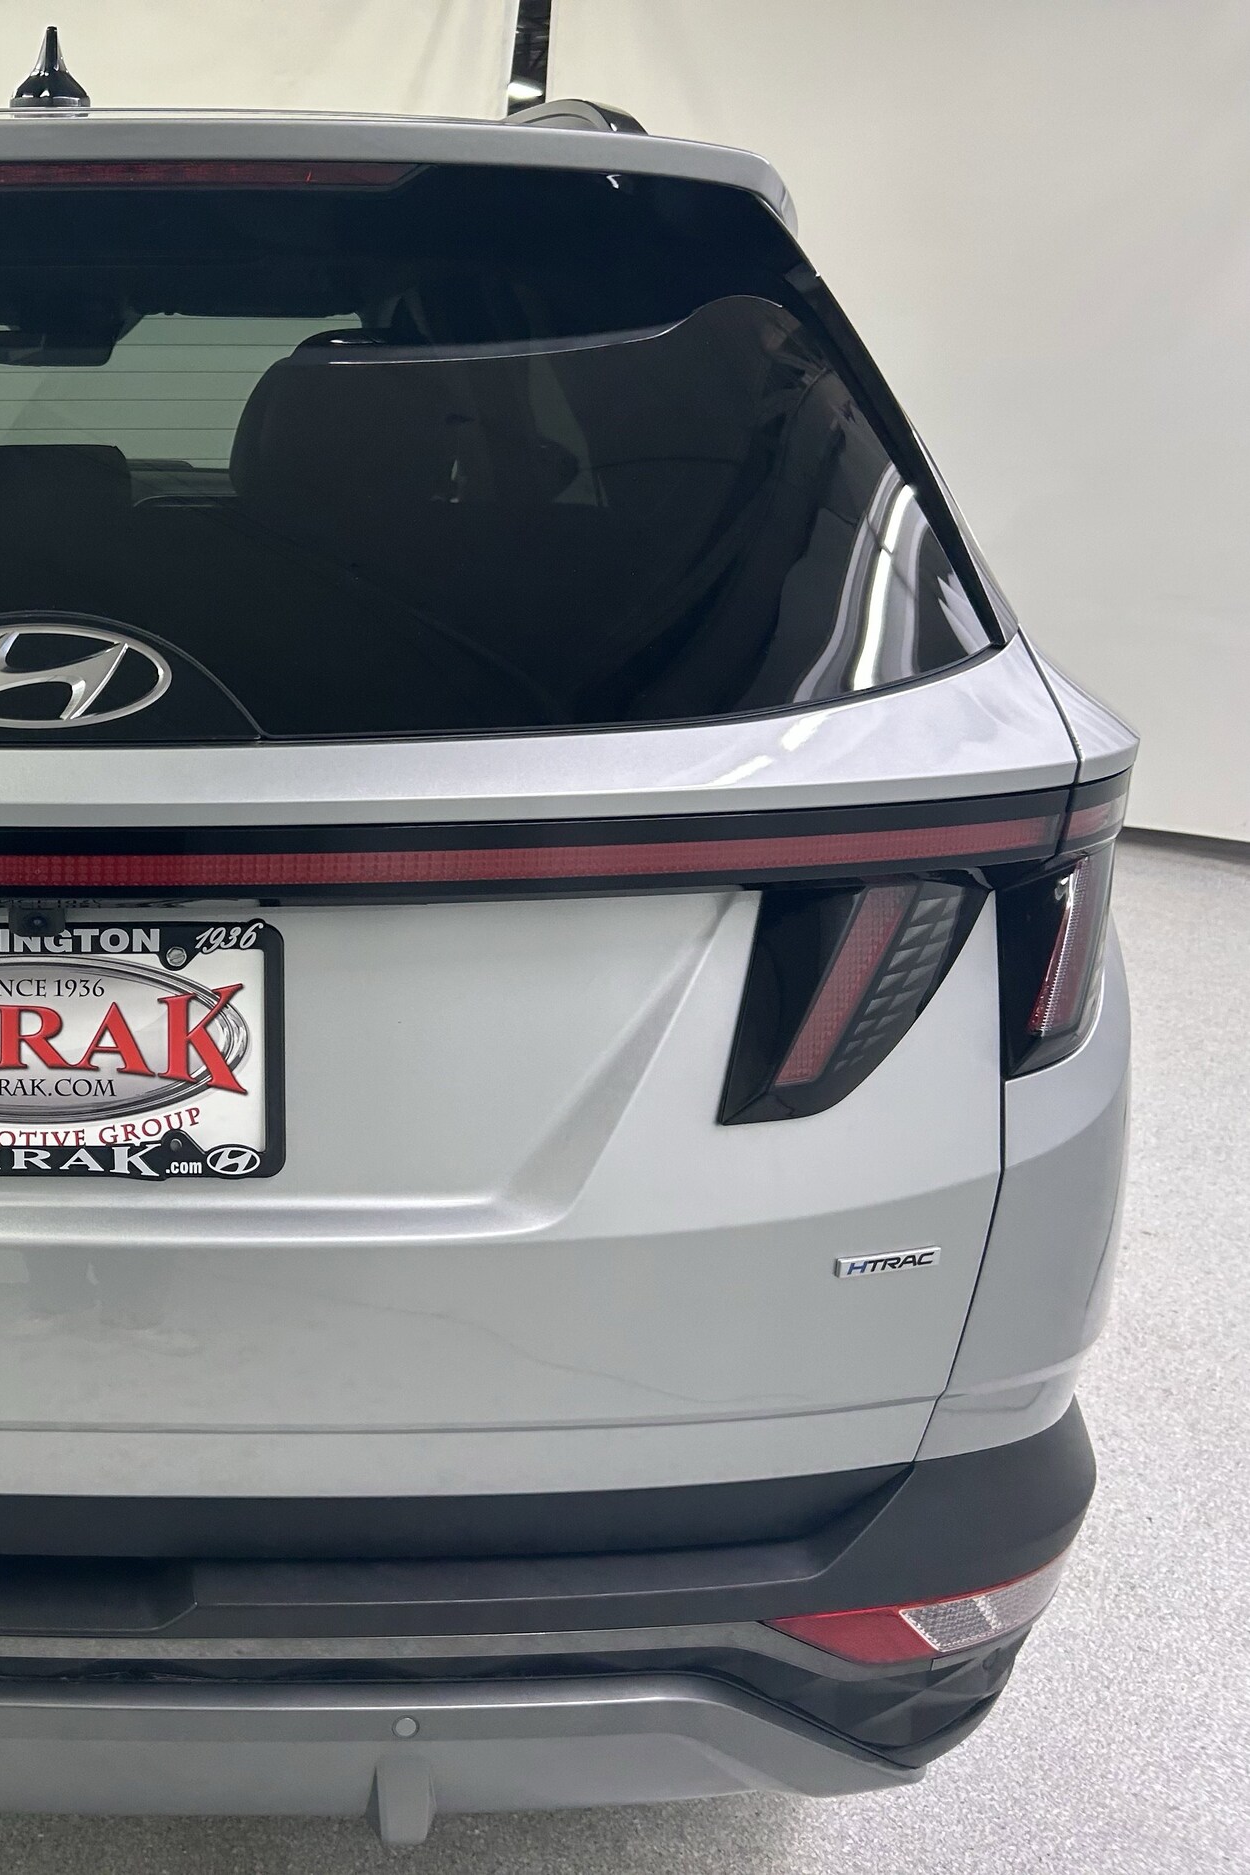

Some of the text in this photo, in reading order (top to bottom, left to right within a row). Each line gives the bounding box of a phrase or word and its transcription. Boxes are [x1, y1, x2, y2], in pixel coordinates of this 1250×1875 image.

[194, 923, 264, 953] 1936
[53, 978, 106, 998] 1936
[98, 1106, 202, 1145] GROUP
[847, 1251, 934, 1275] HTRAC
